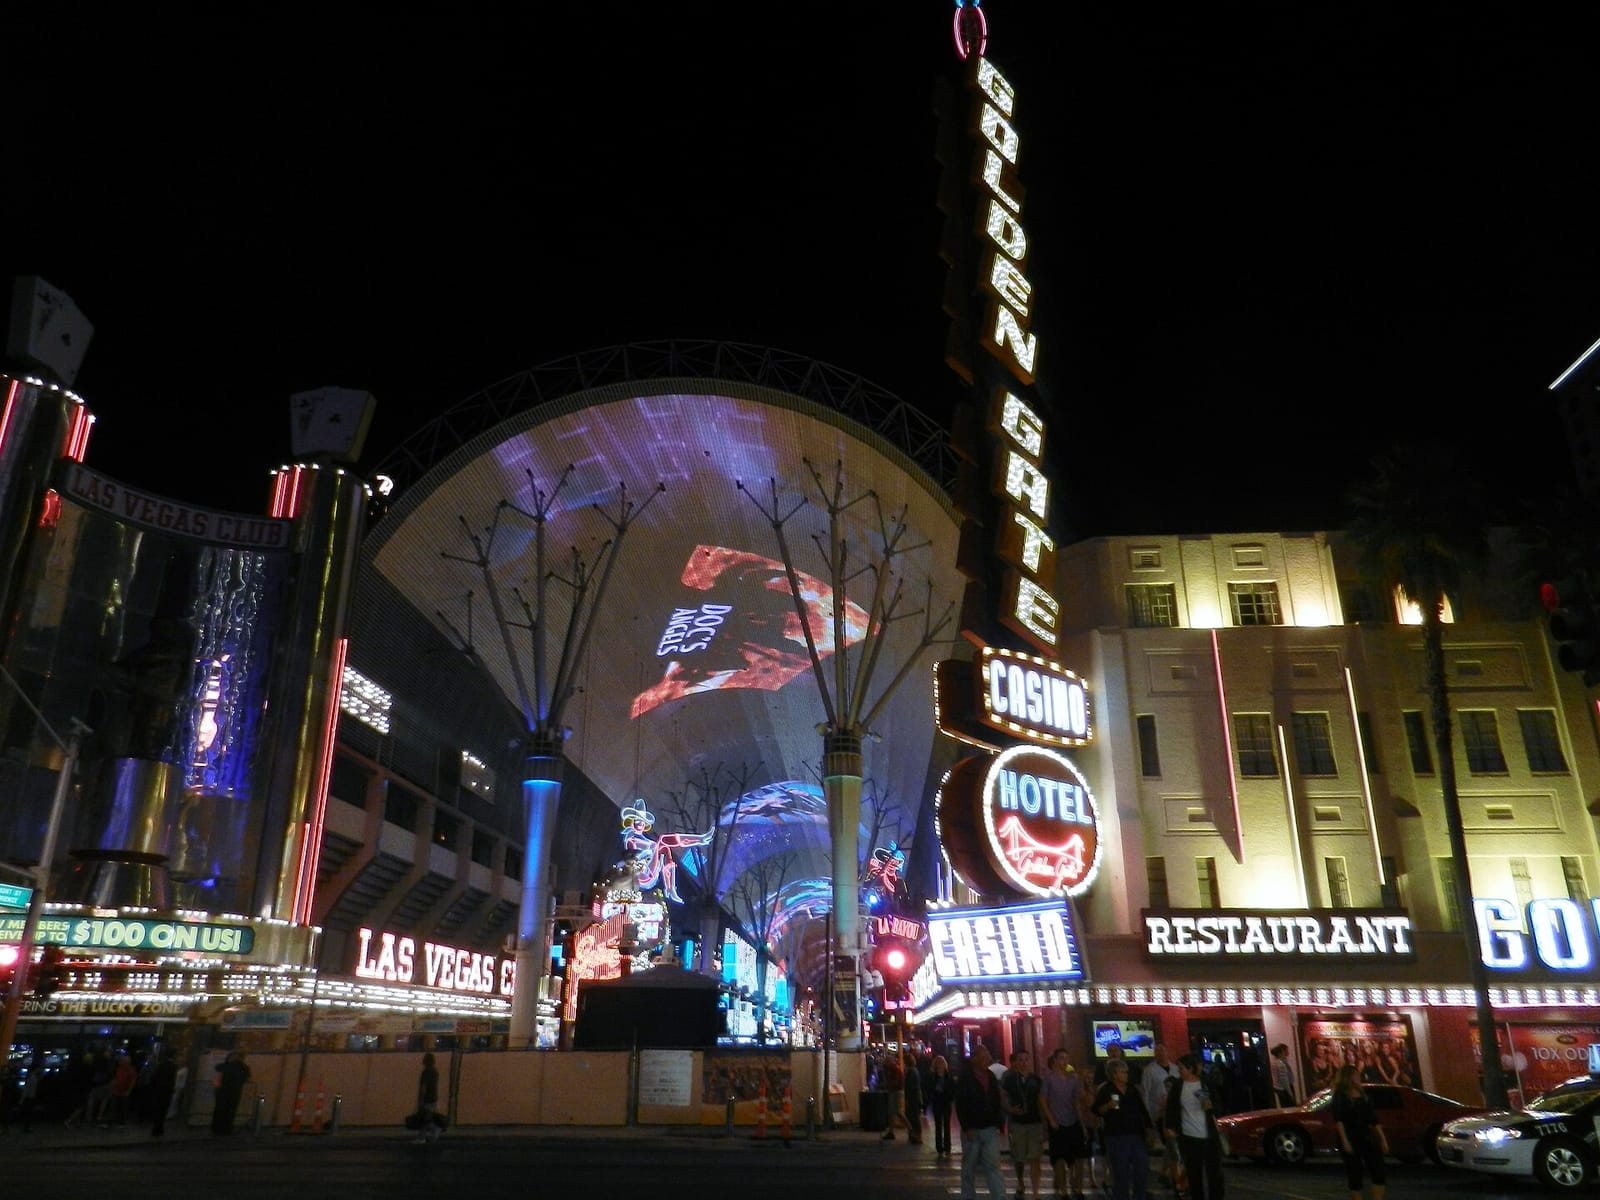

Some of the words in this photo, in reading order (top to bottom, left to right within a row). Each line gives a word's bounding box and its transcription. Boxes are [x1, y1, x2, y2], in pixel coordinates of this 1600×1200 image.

[977, 56, 1037, 374] GOLDEN
[71, 467, 117, 509] LAS
[123, 491, 209, 537] VEGAS
[215, 516, 284, 546] CLUB
[1001, 391, 1059, 646] GATE
[655, 607, 699, 658] ANGELS
[681, 603, 734, 654] DOC'S
[989, 658, 1087, 736] CASINO
[1000, 768, 1093, 825] HOTEL
[8, 919, 70, 931] MEBERS
[49, 931, 67, 942] TO
[72, 920, 146, 947] $100
[150, 922, 198, 949] ON
[201, 927, 243, 952] US!
[877, 916, 890, 935] LA
[892, 916, 920, 941] BAYOU
[928, 909, 1073, 977] CASINO
[1145, 915, 1412, 955] RESTAURANT
[1472, 897, 1600, 971] GO
[355, 927, 415, 984] LAS
[424, 941, 495, 994] VEGAS
[60, 1001, 88, 1014] THE
[91, 1001, 140, 1014] LUCKY
[1531, 1046, 1561, 1061] 10X
[1564, 1046, 1590, 1061] OD
